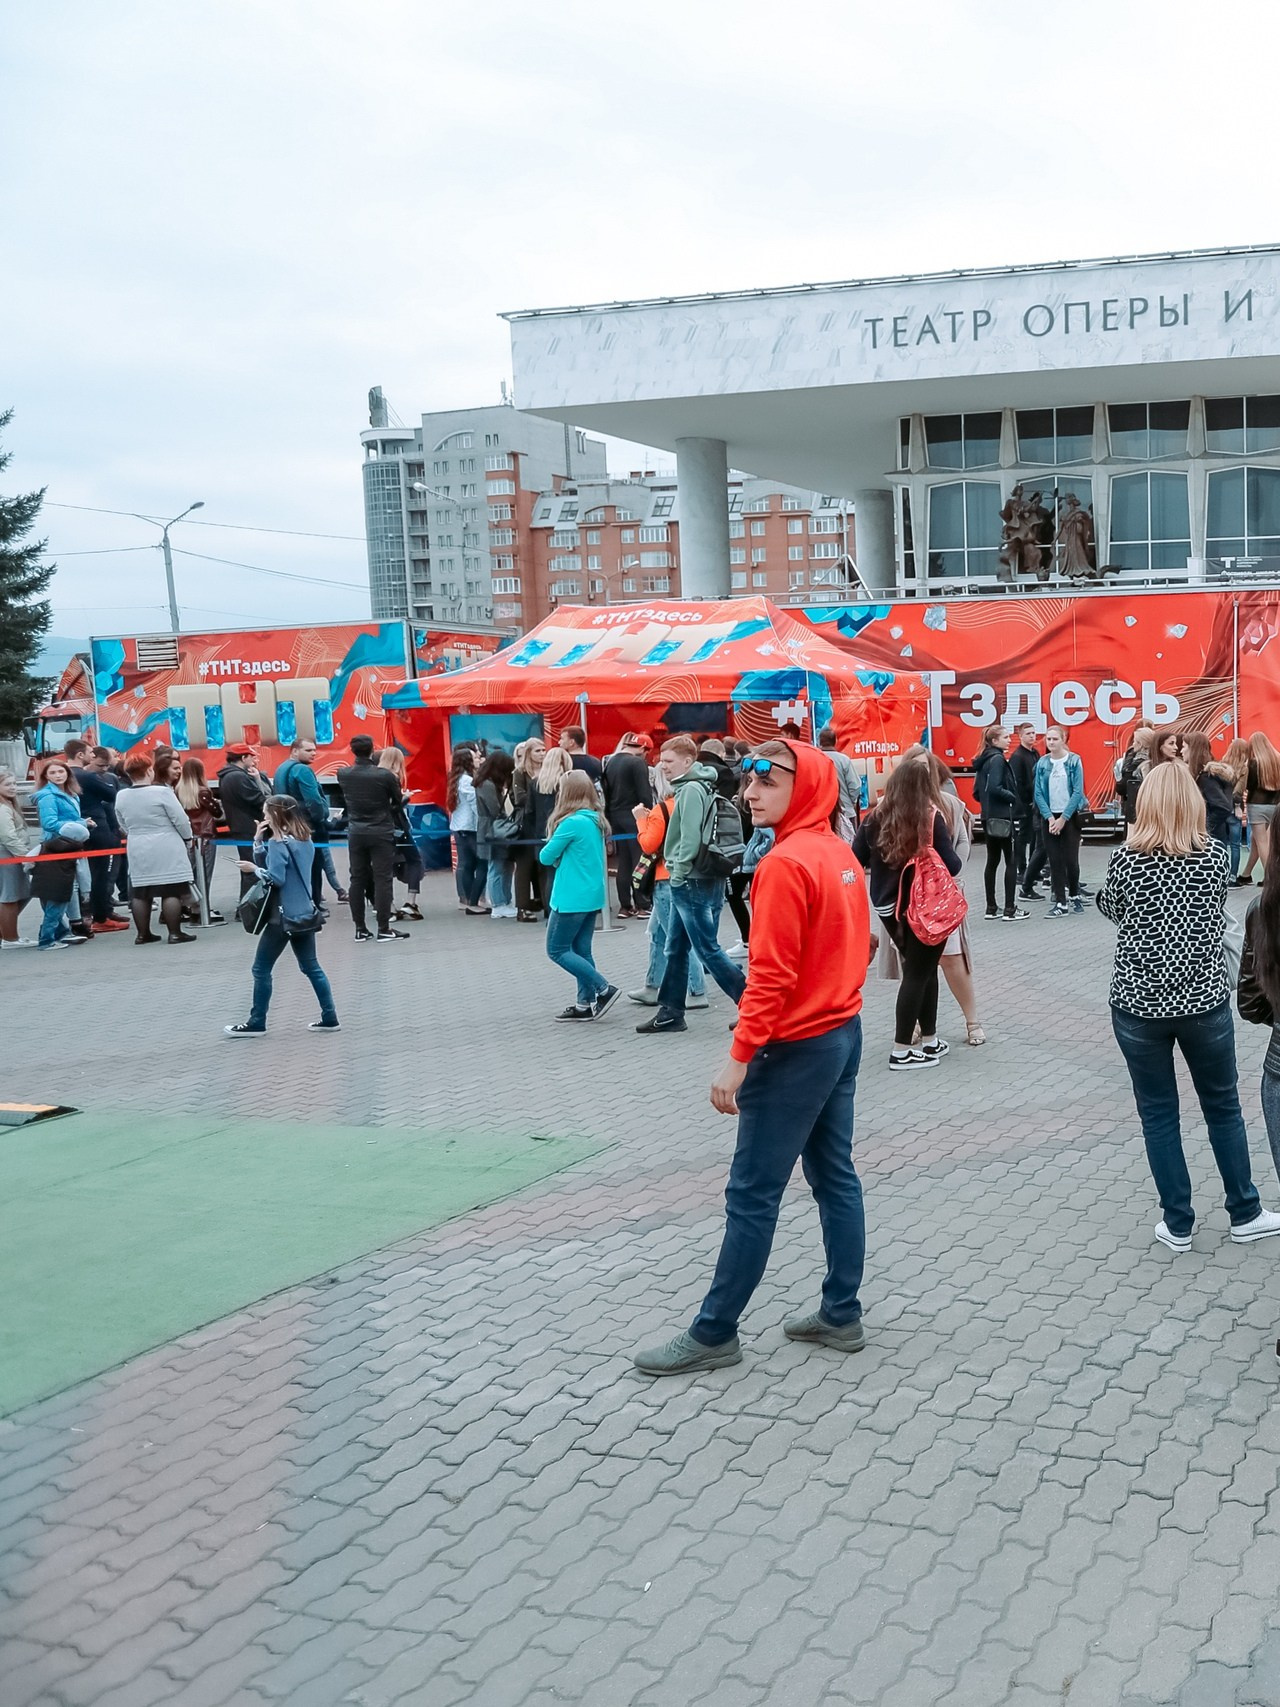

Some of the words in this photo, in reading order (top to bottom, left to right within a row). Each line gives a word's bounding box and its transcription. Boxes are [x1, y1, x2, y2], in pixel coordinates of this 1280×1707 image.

[864, 309, 992, 350] ТЕАТР
[1022, 293, 1189, 338] ОПЕРЫ
[1224, 287, 1253, 323] И
[591, 608, 703, 625] #ТНТздесь
[199, 659, 291, 676] #ТНТздесь
[506, 620, 739, 669] ТНТ
[167, 677, 334, 750] ТНТ
